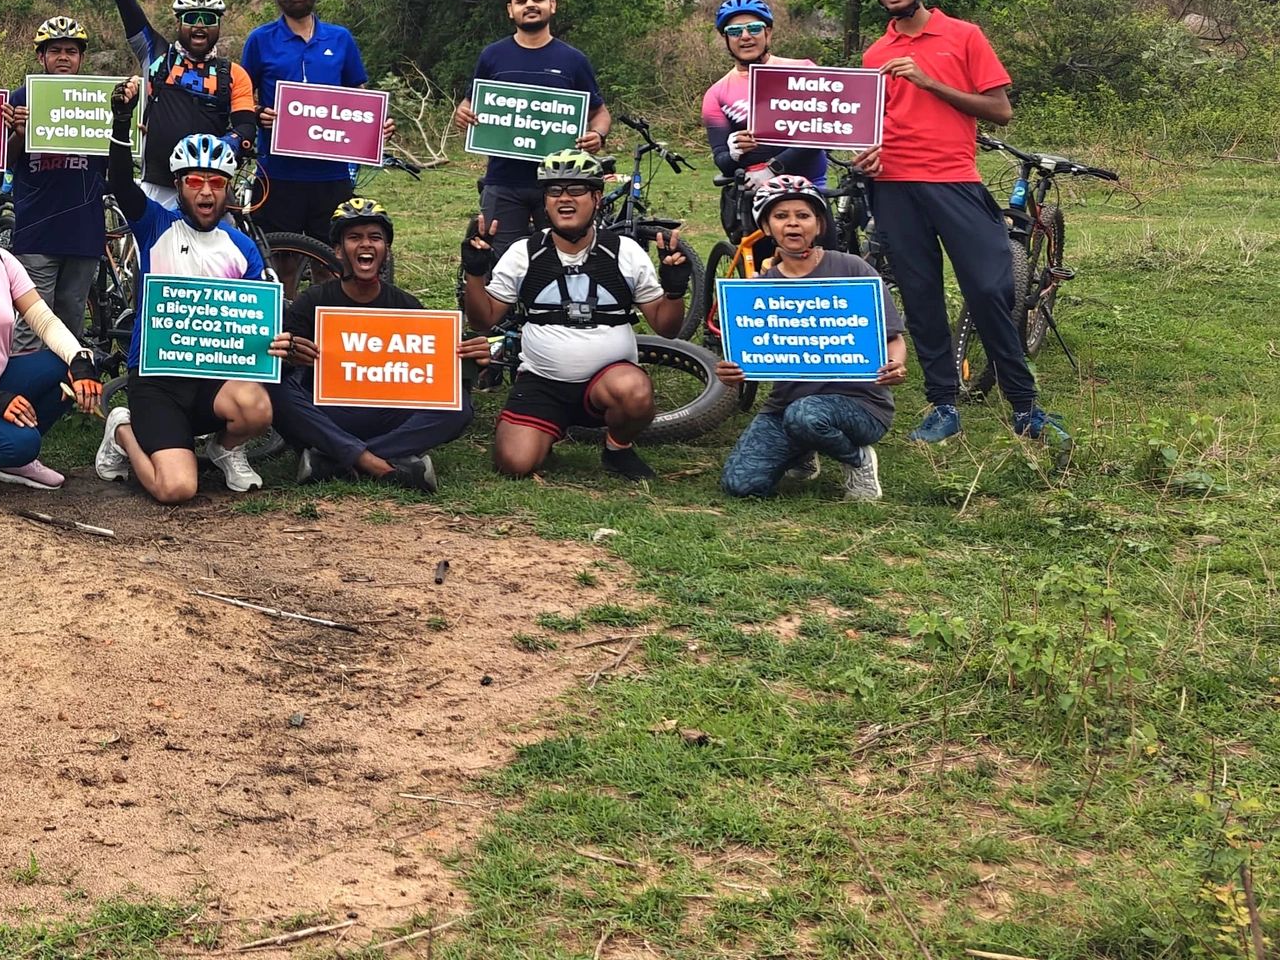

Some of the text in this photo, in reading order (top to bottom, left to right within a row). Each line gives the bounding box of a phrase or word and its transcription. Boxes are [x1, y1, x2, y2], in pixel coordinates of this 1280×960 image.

[787, 76, 844, 93] Make
[62, 88, 108, 104] Think
[484, 92, 576, 116] Keep calm
[49, 106, 114, 124] globally
[288, 100, 375, 124] One Less
[770, 97, 861, 115] roads for
[35, 124, 79, 141] cycle
[477, 112, 578, 136] and bicycle
[774, 117, 854, 137] cyclists
[308, 124, 351, 144] Car.
[513, 136, 537, 150] on
[162, 285, 257, 304] Every 7 KM on
[156, 300, 264, 320] a Bicycle Saves
[753, 295, 848, 314] A bicycle is
[151, 316, 270, 336] 1KG of CO2 That a
[735, 314, 869, 328] the finest mode
[170, 333, 244, 350] Car would
[341, 332, 436, 354] We ARE
[752, 332, 855, 350] of transport
[158, 348, 256, 366] have polluted
[741, 350, 869, 364] known to man.
[340, 361, 434, 384] Traffic!
